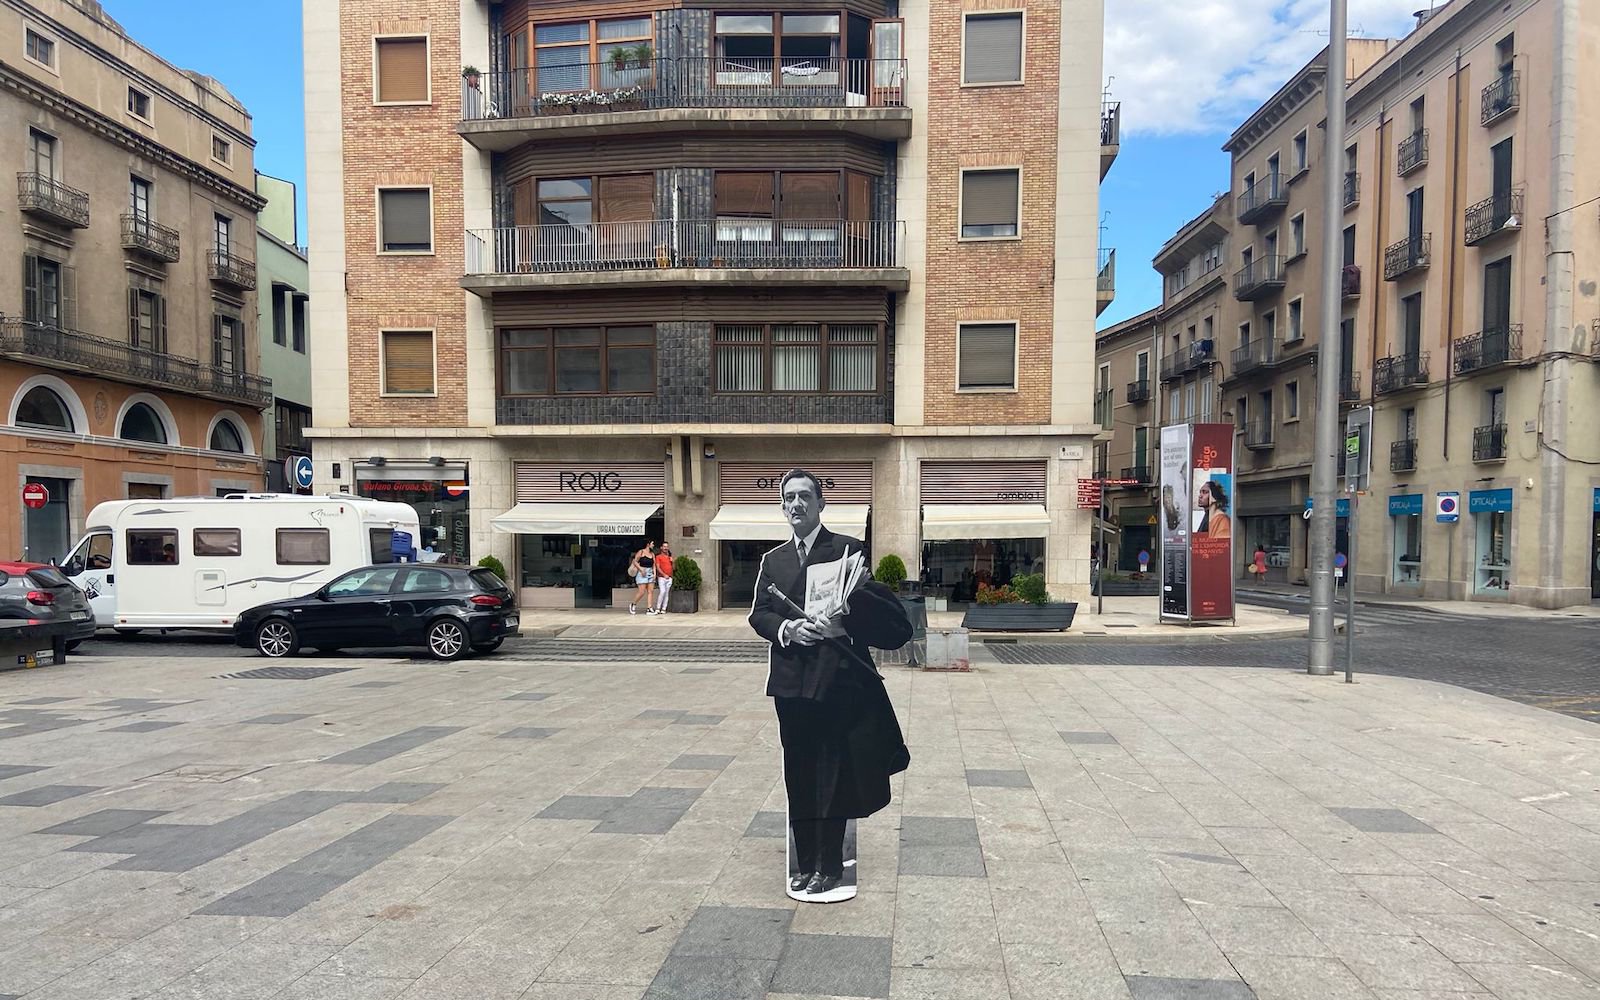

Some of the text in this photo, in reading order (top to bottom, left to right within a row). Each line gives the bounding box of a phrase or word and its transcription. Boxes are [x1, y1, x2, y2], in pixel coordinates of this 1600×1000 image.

[560, 471, 622, 492] ROIG
[363, 482, 391, 491] Butano
[997, 491, 1033, 500] rambla
[597, 525, 644, 534] URBAN COMFORT
[453, 520, 464, 559] Butano
